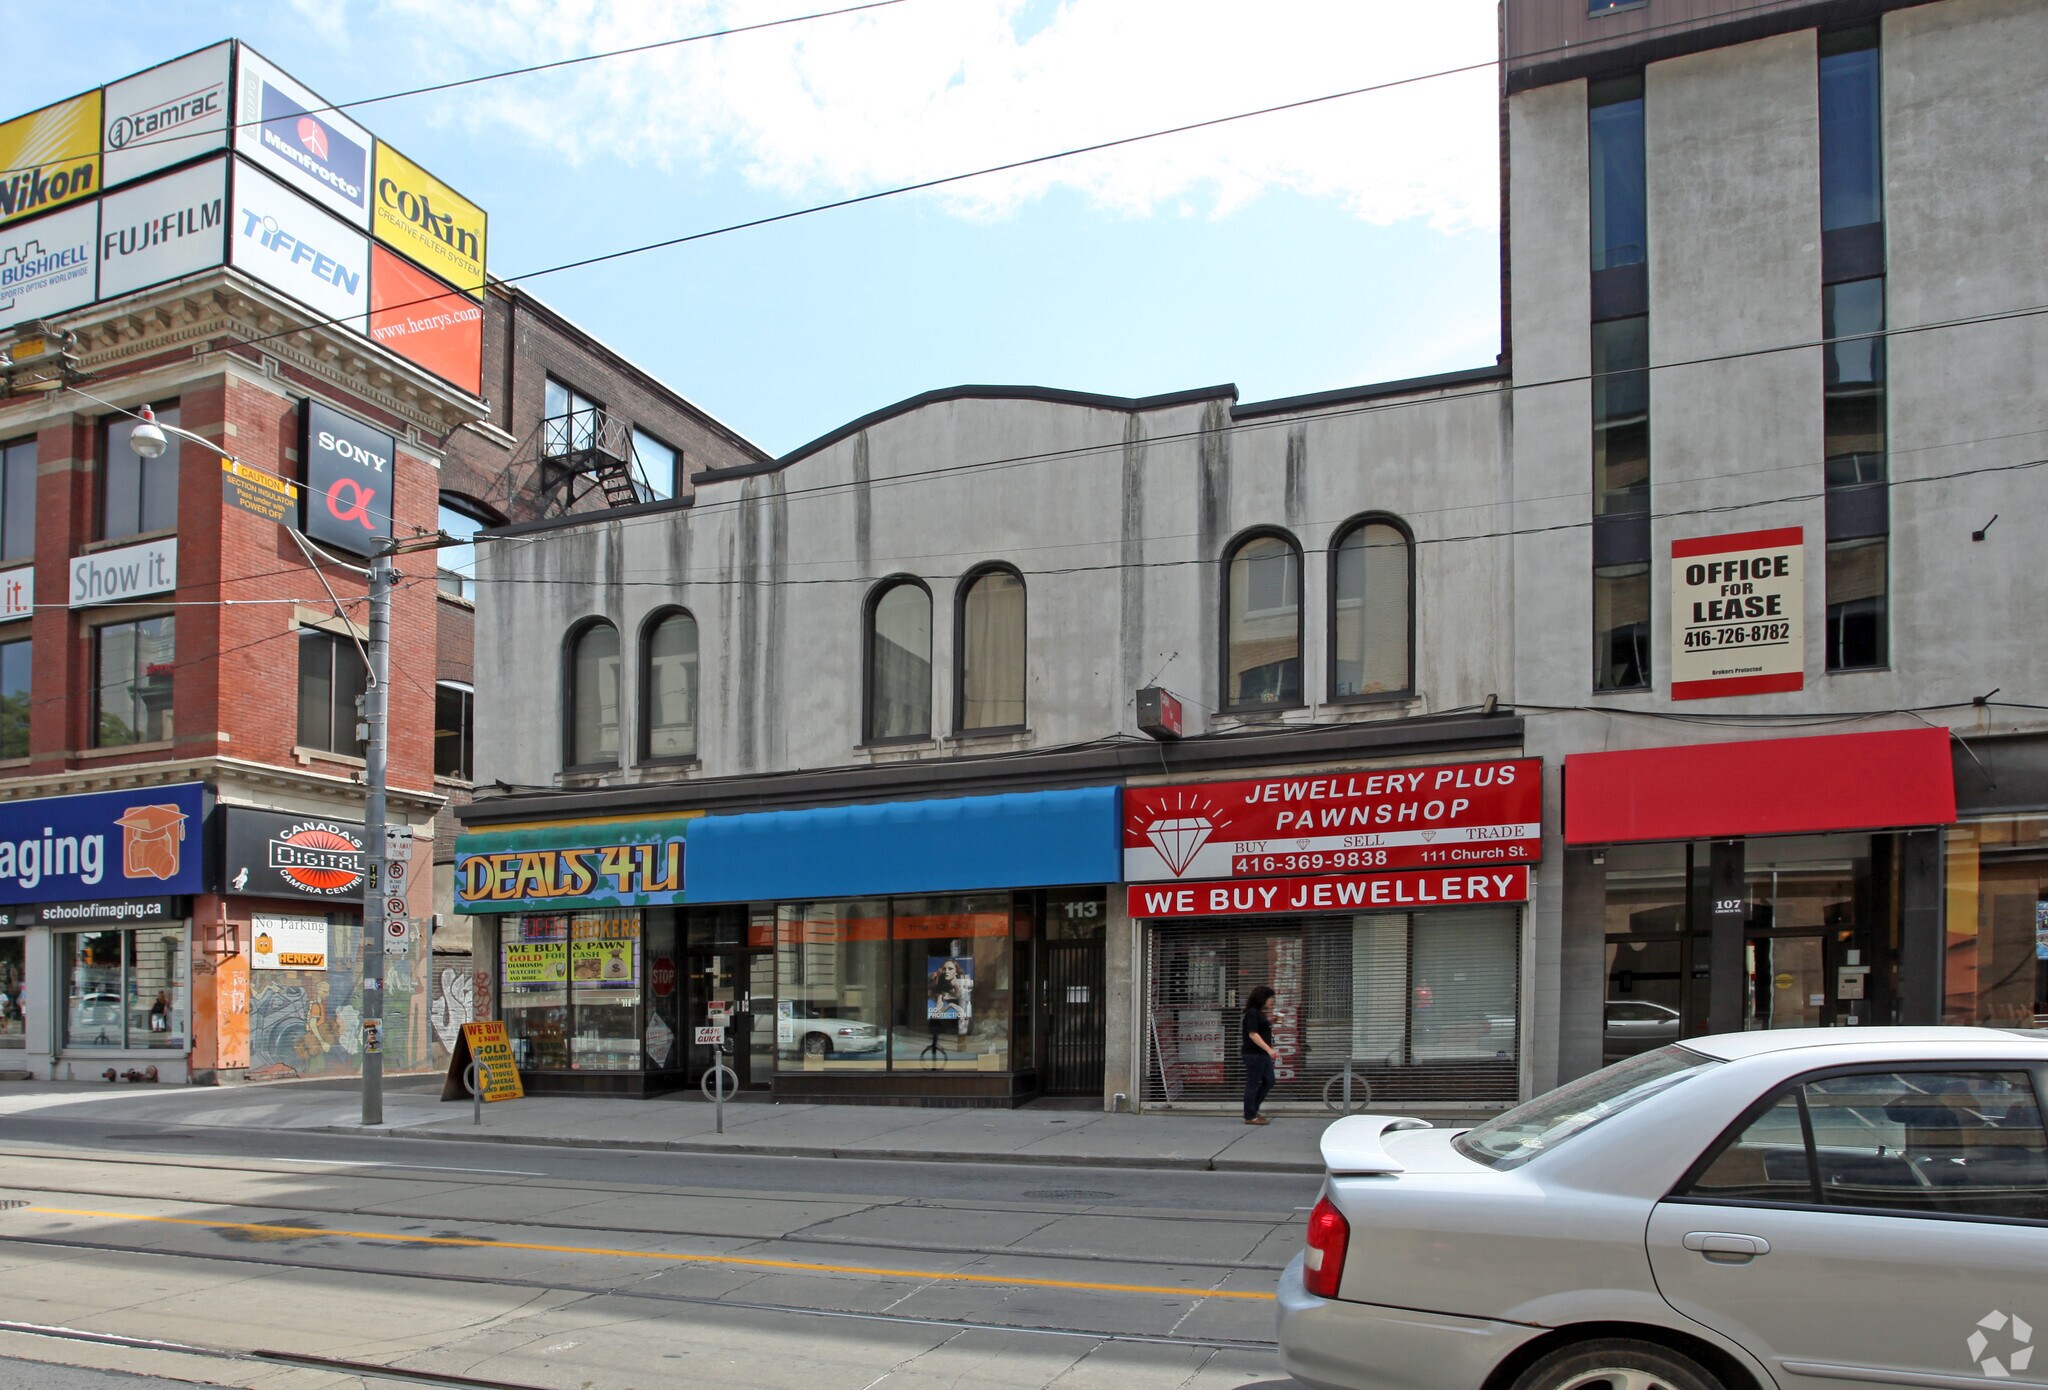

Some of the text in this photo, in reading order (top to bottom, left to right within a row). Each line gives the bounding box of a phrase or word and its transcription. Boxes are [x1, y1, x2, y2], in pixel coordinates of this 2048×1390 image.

[134, 91, 218, 137] tamrac
[264, 128, 357, 198] Manfrotto
[0, 163, 93, 215] Nikon
[104, 198, 222, 260] FUJIFILM
[379, 177, 480, 263] cokin
[377, 207, 480, 278] CREATIVE FILTER SYSTEM
[2, 245, 88, 286] BUSHNELL
[25, 277, 48, 293] OPTICS
[49, 266, 89, 286] WORLDWIDE
[373, 307, 480, 341] www.henrys.com
[318, 431, 387, 473] SONY
[226, 474, 295, 508] SECTION INSULATOR
[241, 467, 281, 490] CAUTION
[236, 488, 286, 512] Pass under with
[239, 497, 283, 520] POWER OFF
[75, 551, 171, 601] Show it.
[1686, 555, 1789, 586] OFFICE
[7, 579, 28, 614] it.
[1721, 582, 1753, 597] FOR
[1693, 594, 1782, 623] LEASE
[1684, 623, 1790, 648] 416-726-8782
[1712, 666, 1763, 676] Brokers Protected
[1245, 765, 1516, 804] JEWELLERY PLUS
[1275, 799, 1470, 831] PAWNSHOP
[279, 821, 364, 850] CANADA'S
[1234, 825, 1526, 853] BUY SELL TRADE
[276, 846, 365, 871] DIGITAL
[1236, 850, 1388, 873] 416-369-9838
[1421, 846, 1528, 862] 111 Church St.
[279, 869, 364, 896] CAMERA CENTRE
[1145, 873, 1514, 914] WE BUY JEWELLERY
[42, 902, 161, 920] schoolofimaging.ca
[1065, 902, 1098, 918] 113
[1716, 900, 1741, 909] 107
[255, 916, 325, 933] No Parking
[571, 918, 641, 939] BROKERS
[508, 945, 530, 953] WE
[534, 943, 564, 952] BUY
[587, 941, 625, 950] PAWN
[509, 954, 543, 962] GOLD
[653, 970, 674, 984] STOP
[468, 1023, 503, 1035] WE BUY
